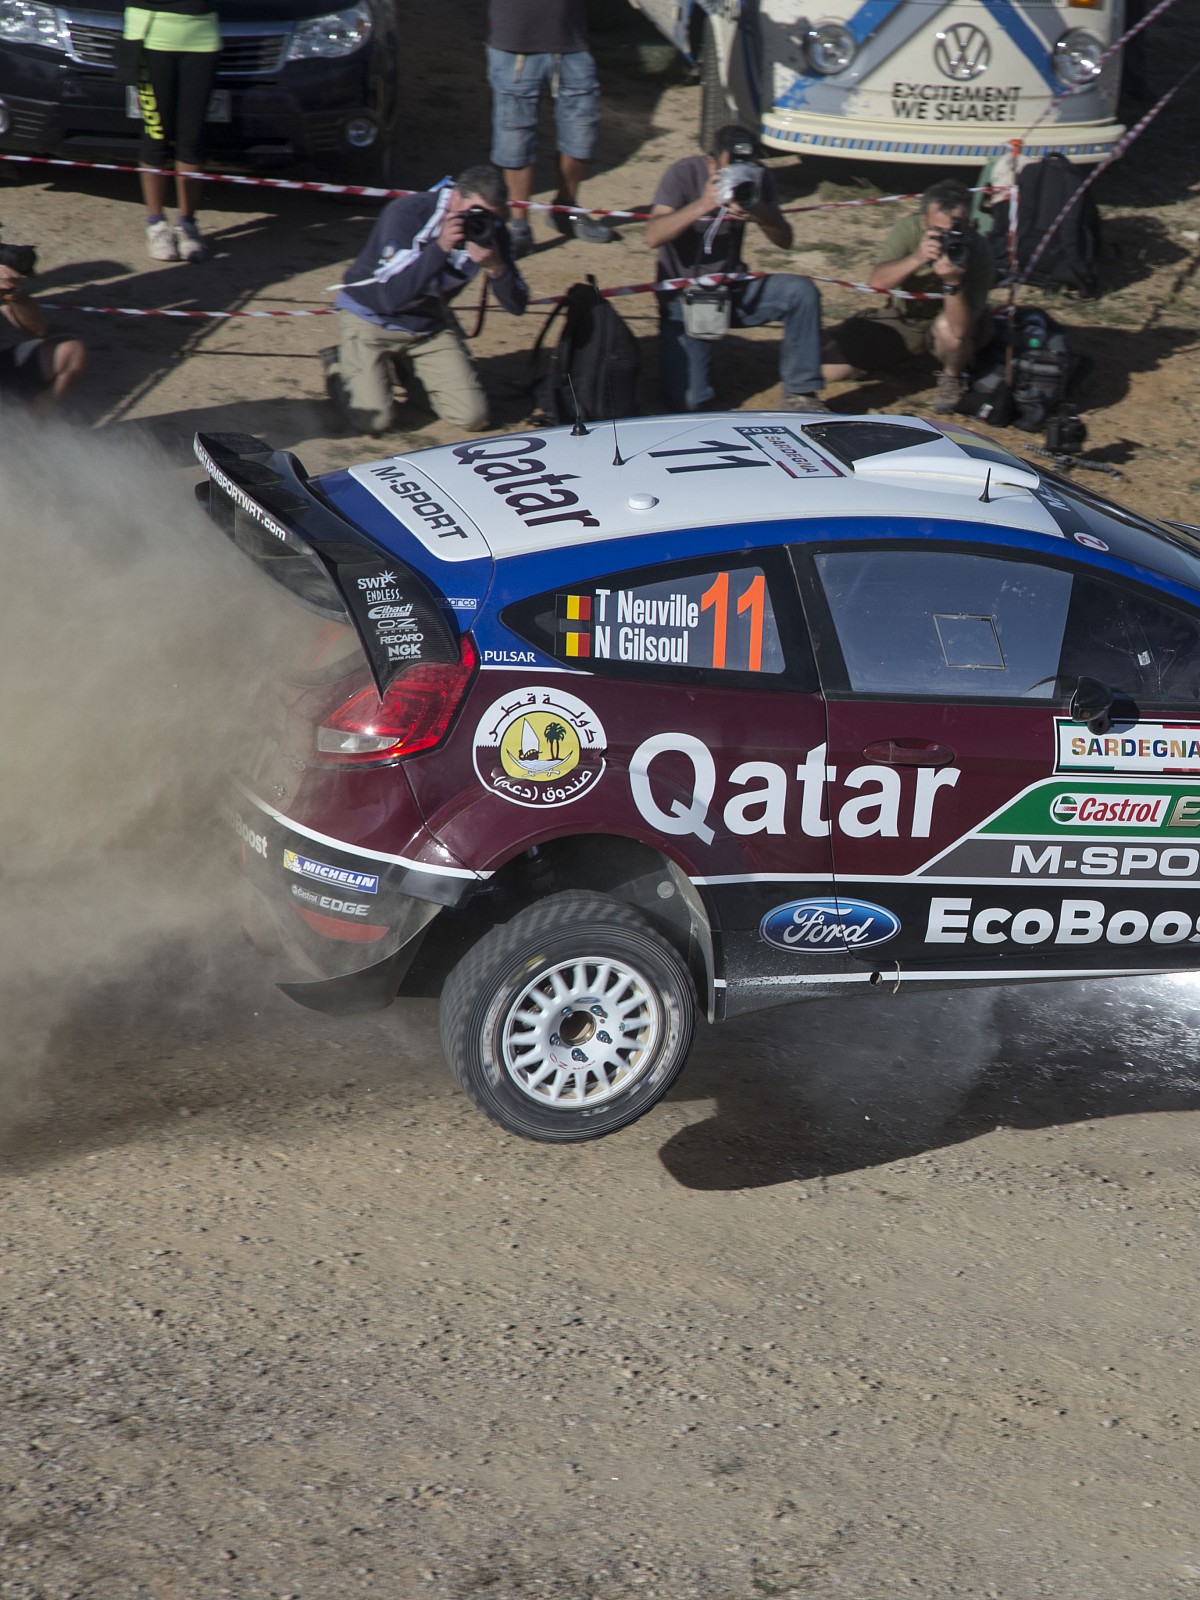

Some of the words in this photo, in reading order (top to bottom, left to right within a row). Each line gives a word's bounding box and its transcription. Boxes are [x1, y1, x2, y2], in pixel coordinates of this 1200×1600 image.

[892, 82, 1022, 102] EXCITEMENT
[892, 99, 928, 120] WE
[935, 103, 1016, 122] SHARE!
[647, 440, 772, 474] 11
[764, 435, 820, 473] SARDEGNA
[452, 436, 600, 527] Qatar
[357, 576, 390, 590] SWP
[366, 588, 400, 602] ENDLESS
[368, 604, 414, 619] Eibach
[595, 588, 611, 622] T
[617, 589, 699, 628] Neuville
[700, 572, 765, 671] 11
[380, 633, 424, 645] RECARO
[388, 643, 422, 657] NGK
[594, 625, 611, 658] N
[618, 627, 689, 664] Gilsoul
[484, 650, 536, 662] PULSAR
[542, 770, 593, 802] صندوق
[628, 731, 961, 845] Qatar
[1078, 796, 1162, 824] Castrol
[302, 861, 375, 888] MICHELIN
[297, 888, 318, 903] Castrol
[319, 896, 371, 916] EDGE
[784, 904, 870, 947] Ford
